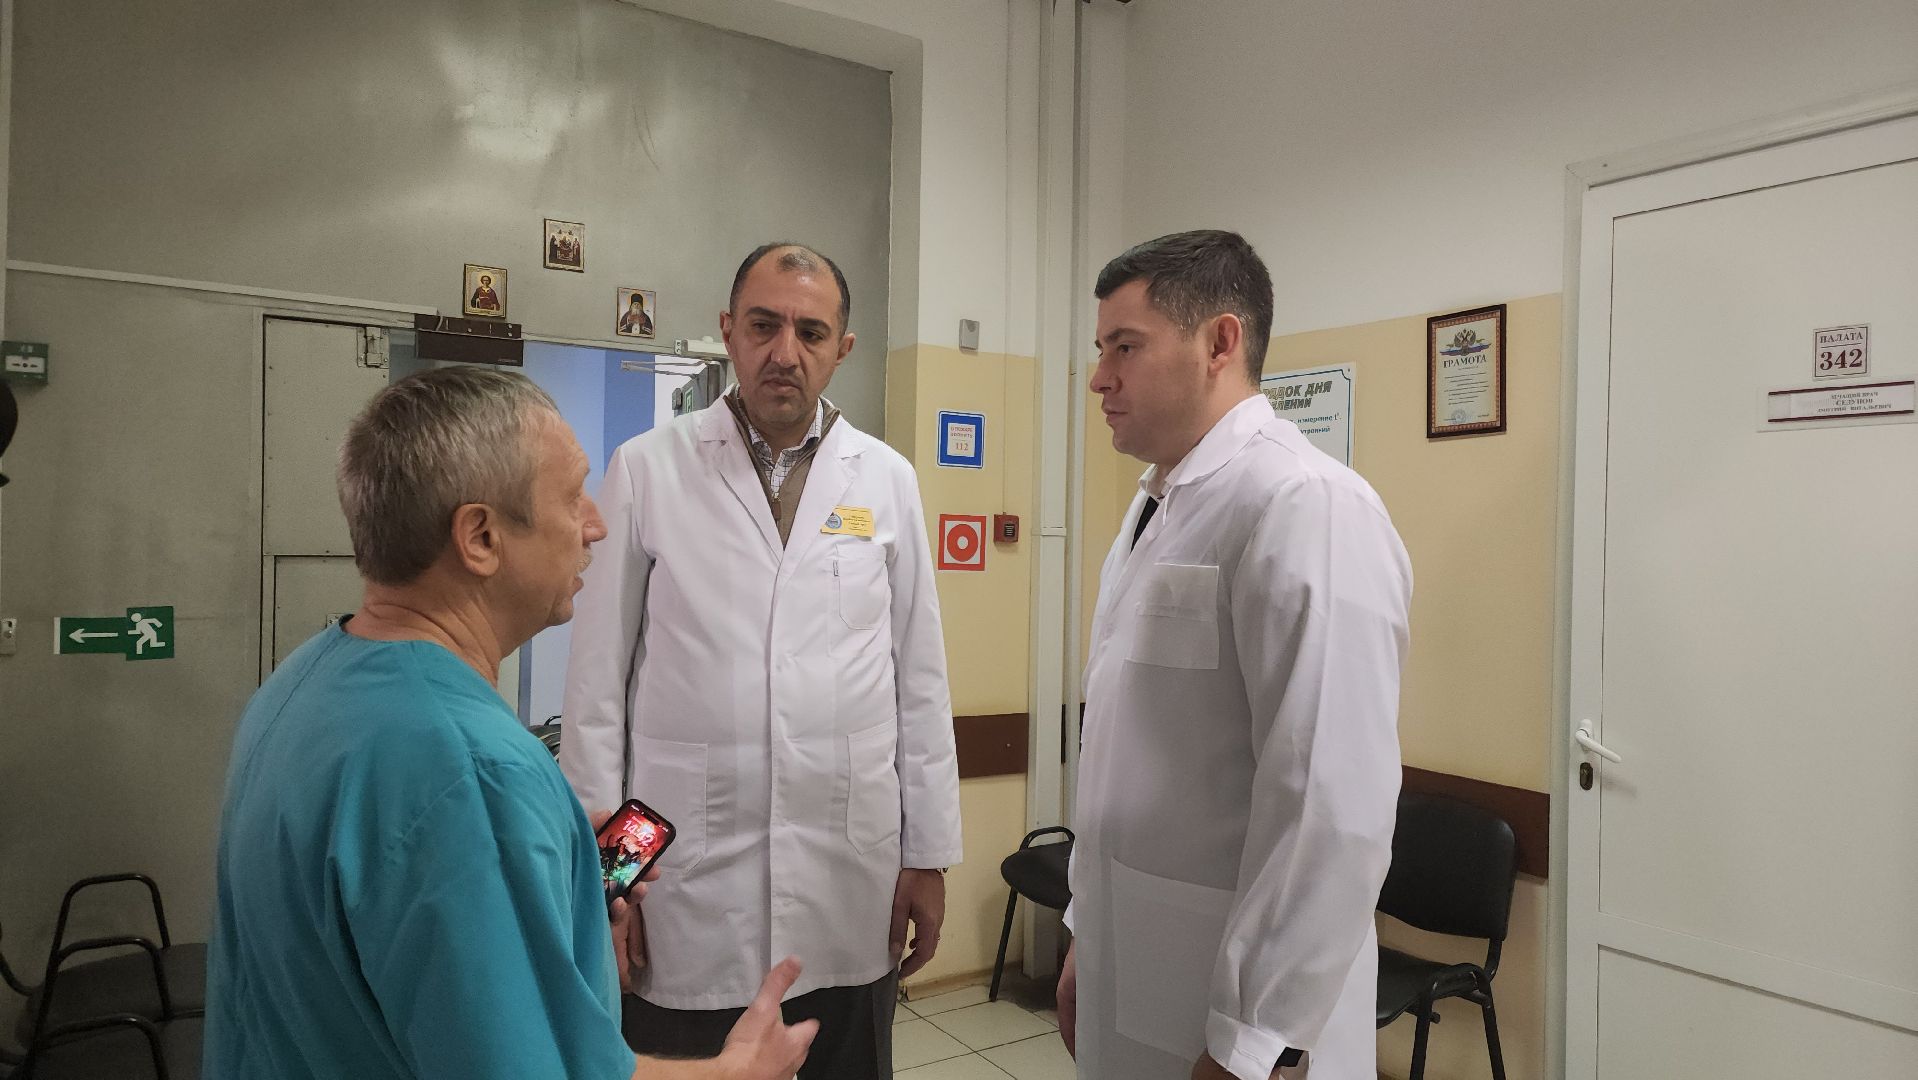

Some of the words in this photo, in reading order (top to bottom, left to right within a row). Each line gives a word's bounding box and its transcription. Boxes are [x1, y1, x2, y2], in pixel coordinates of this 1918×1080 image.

[1820, 332, 1863, 343] ПАЛАТА
[1443, 354, 1487, 368] ГРАМОТА
[1820, 349, 1862, 370] 342
[1263, 384, 1302, 400] РЯДОК
[1304, 381, 1332, 397] ДНЯ
[956, 442, 968, 451] 112
